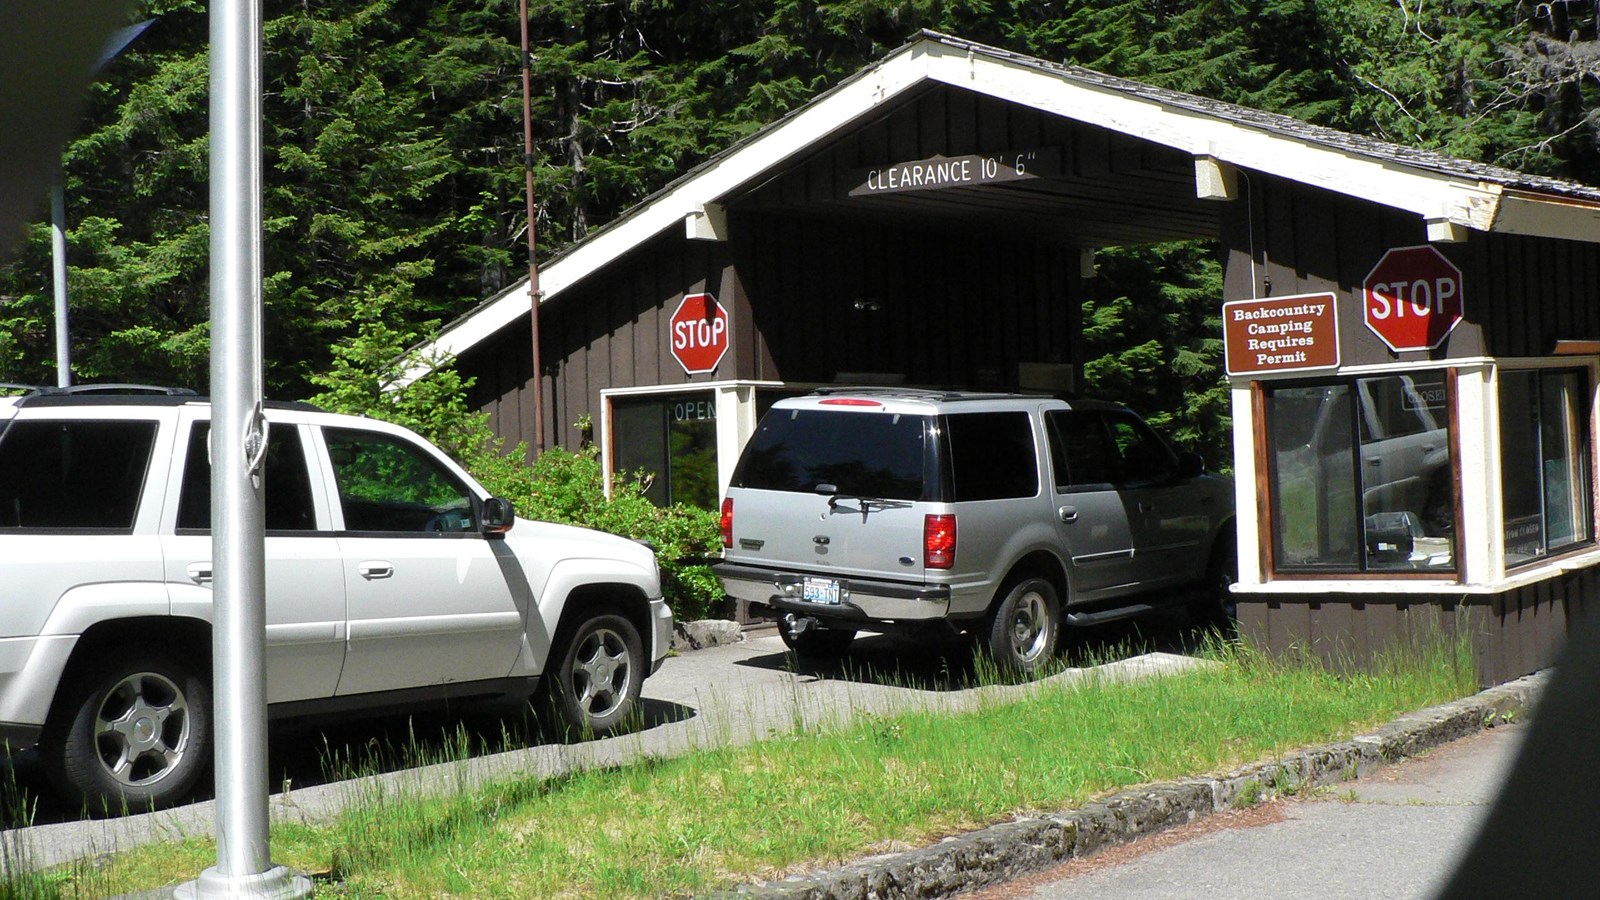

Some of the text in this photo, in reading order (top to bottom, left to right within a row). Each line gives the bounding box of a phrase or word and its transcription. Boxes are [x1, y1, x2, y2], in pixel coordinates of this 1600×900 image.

[868, 160, 971, 190] CLEARANCE
[1371, 277, 1456, 320] STOP
[1233, 304, 1326, 321] Backcountry
[675, 317, 724, 349] STOP
[1247, 320, 1313, 335] Camping
[1247, 335, 1314, 351] Requires
[1256, 351, 1307, 365] Permit
[675, 402, 717, 421] OPEN
